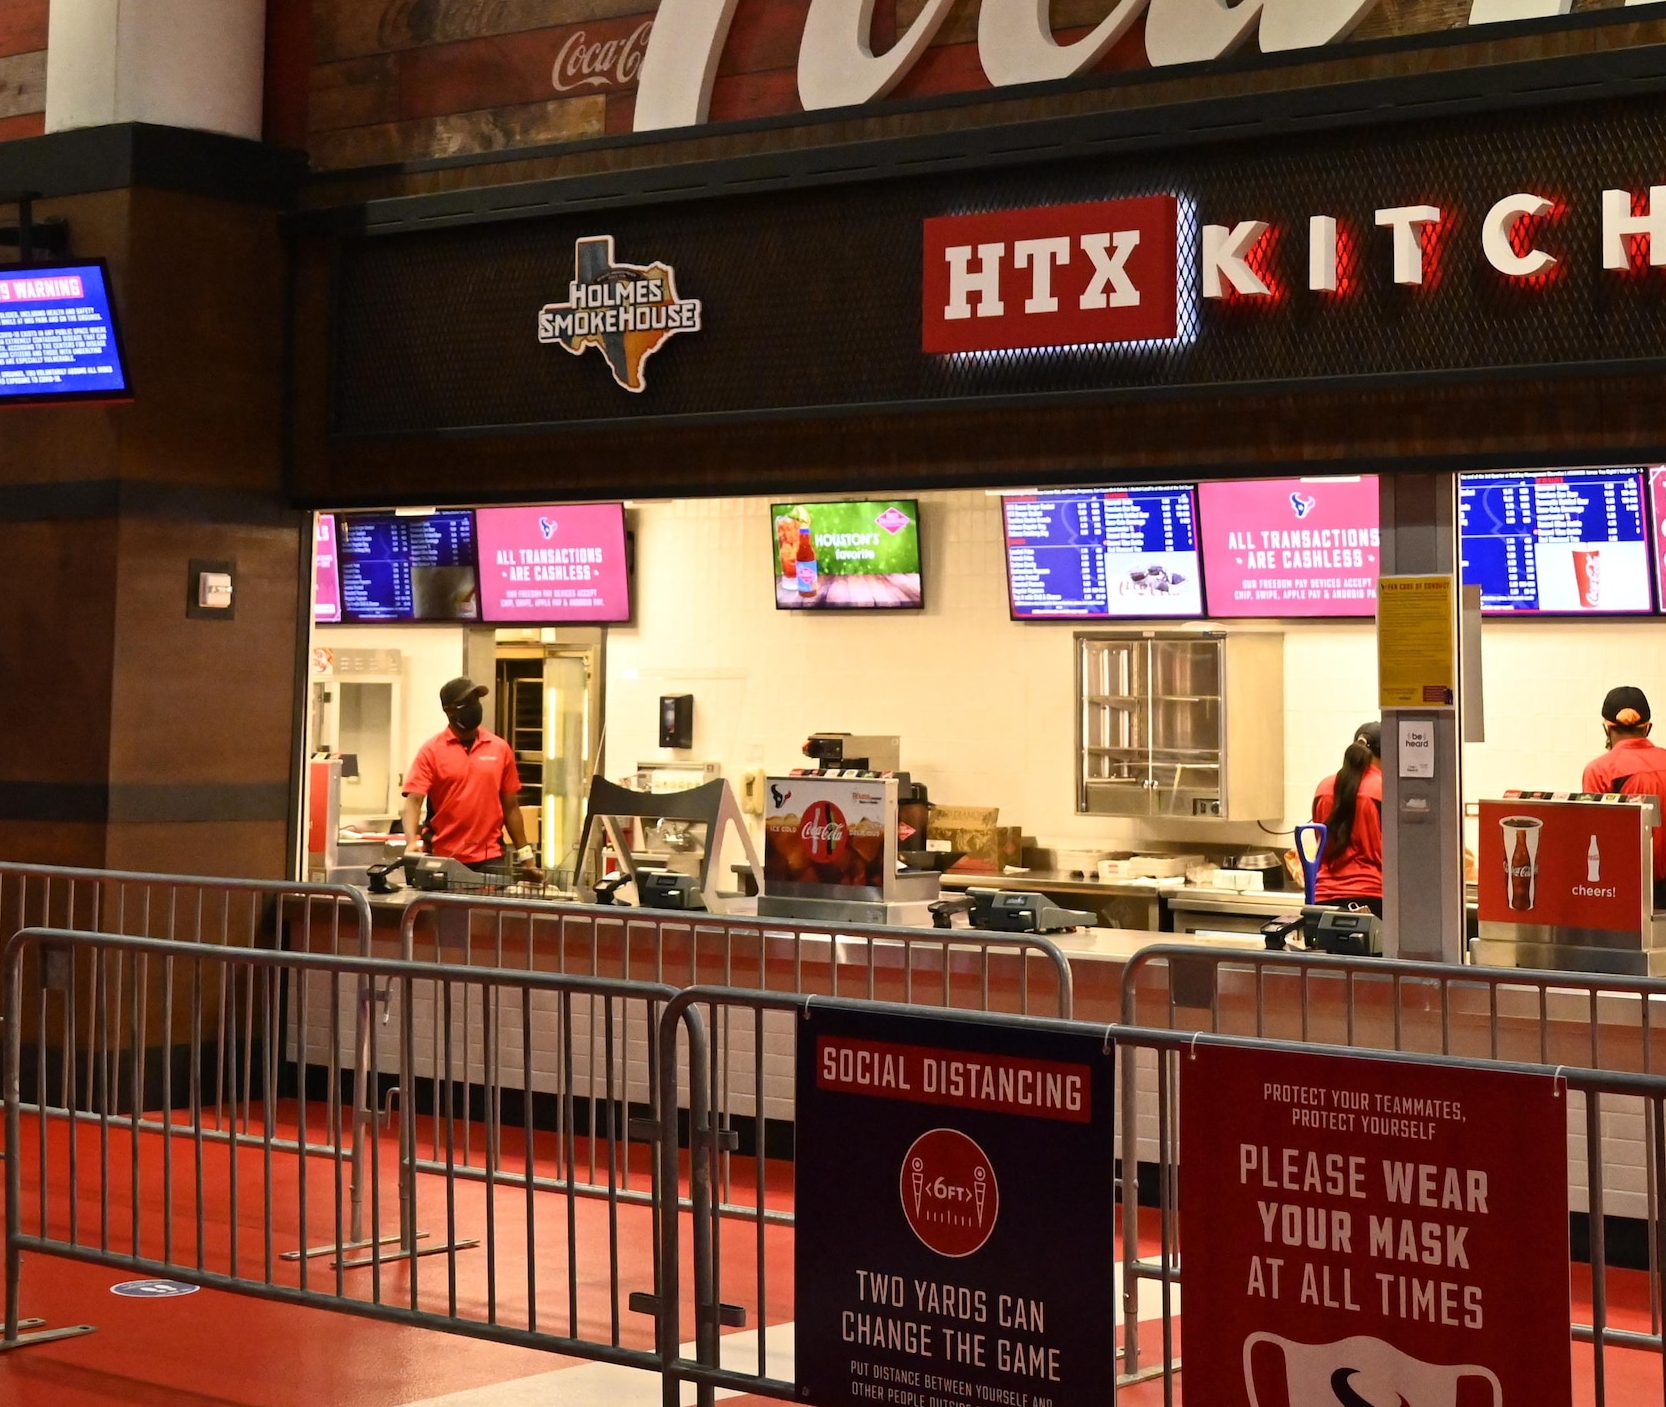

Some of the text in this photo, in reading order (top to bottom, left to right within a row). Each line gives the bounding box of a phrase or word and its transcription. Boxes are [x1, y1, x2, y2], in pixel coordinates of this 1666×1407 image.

[14, 279, 81, 298] WARNING
[944, 229, 1140, 321] HTX
[571, 280, 663, 309] HOLMES
[540, 304, 694, 338] SMOKEHOUSE
[815, 532, 880, 548] HOUSTON'S
[835, 548, 875, 560] favorite
[1229, 528, 1380, 550] ALL TRANSACTIONS
[497, 548, 602, 564] ALL TRANSACTIONS
[1248, 549, 1363, 569] ARE CASHLESS
[510, 566, 591, 581] ARE CASHLESS
[1406, 740, 1429, 748] heard
[1572, 885, 1616, 897] cheers!
[823, 1047, 1081, 1111] SOCIAL DISTANCING
[1264, 1083, 1467, 1123] PROTECT YOUR TEAMMATES,
[1292, 1108, 1436, 1140] PROTECT YOURSELF
[1240, 1144, 1489, 1214] PLEASE WEAR
[1257, 1200, 1470, 1270] YOUR MASK
[856, 1271, 1045, 1333] TWO YARDS CAN
[1247, 1255, 1484, 1329] AT ALL TIMES
[842, 1311, 1061, 1381] CHANGE THE GAME
[851, 1360, 869, 1376] PUT
[873, 1364, 920, 1387] DISTANCE
[925, 1375, 972, 1397] BETWEEN
[975, 1384, 1028, 1407] YOURSELF
[852, 1382, 883, 1400] OTHER
[888, 1388, 925, 1407] PEOPLE
